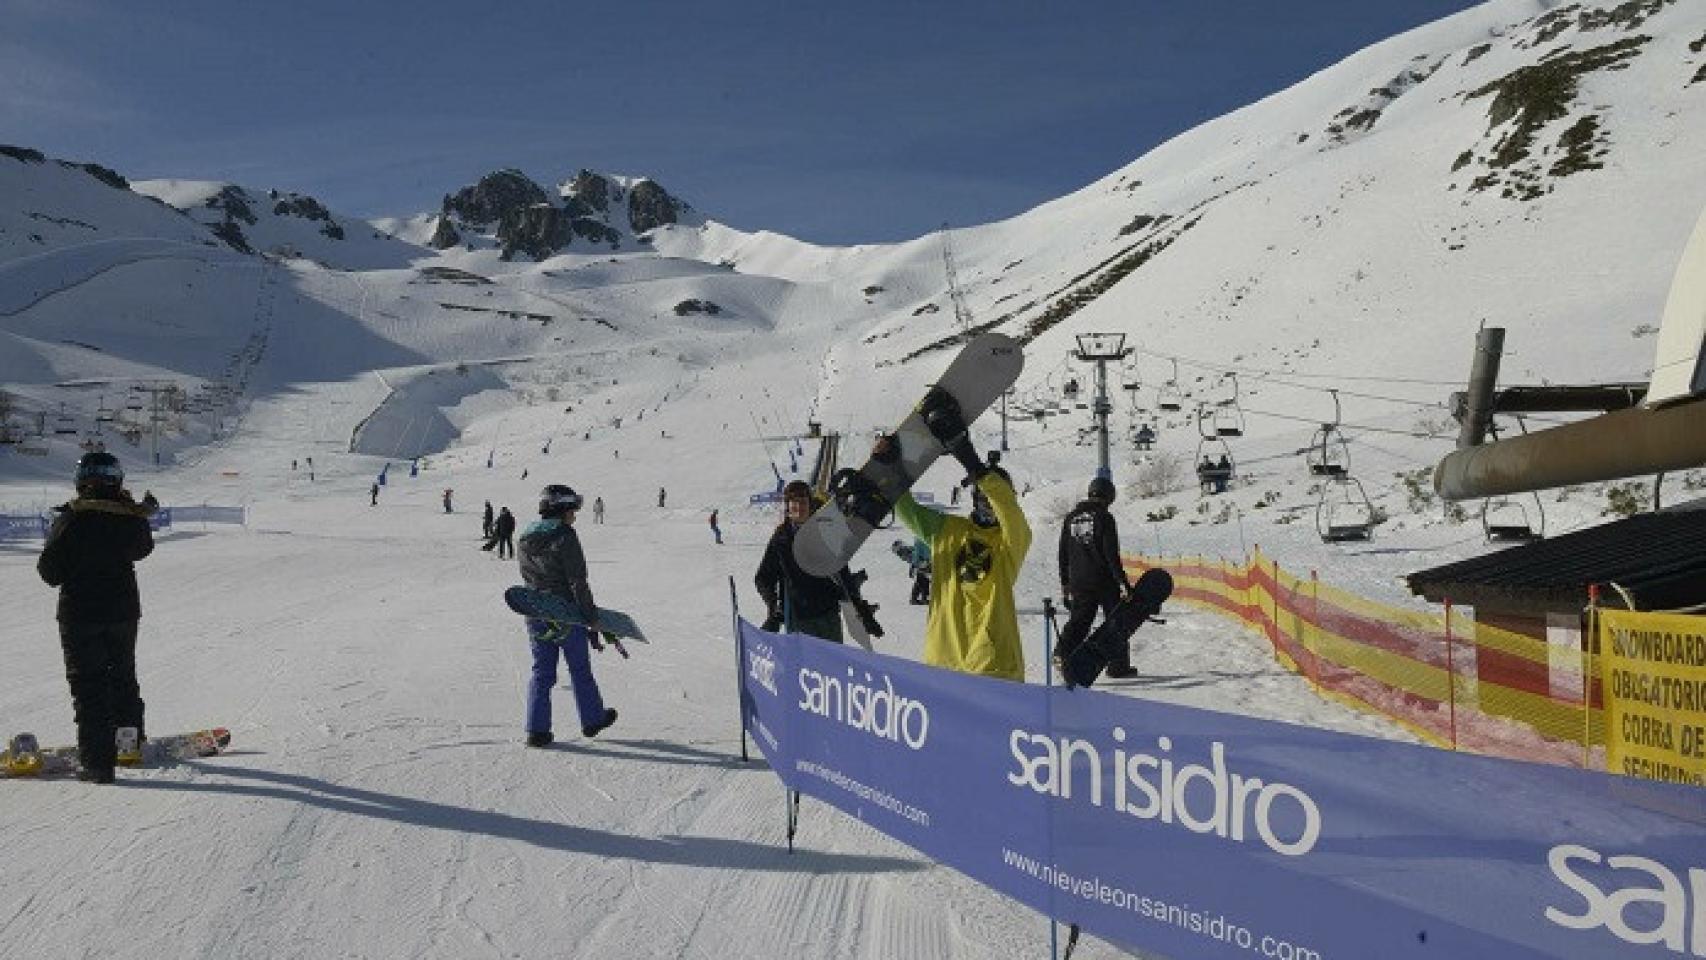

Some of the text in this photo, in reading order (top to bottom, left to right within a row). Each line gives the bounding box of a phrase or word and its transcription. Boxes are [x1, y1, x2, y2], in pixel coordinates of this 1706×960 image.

[798, 667, 842, 721] san
[847, 666, 929, 749] isidro
[1681, 725, 1705, 758] DE
[1008, 727, 1321, 855] san isidro
[1544, 844, 1706, 956] sa
